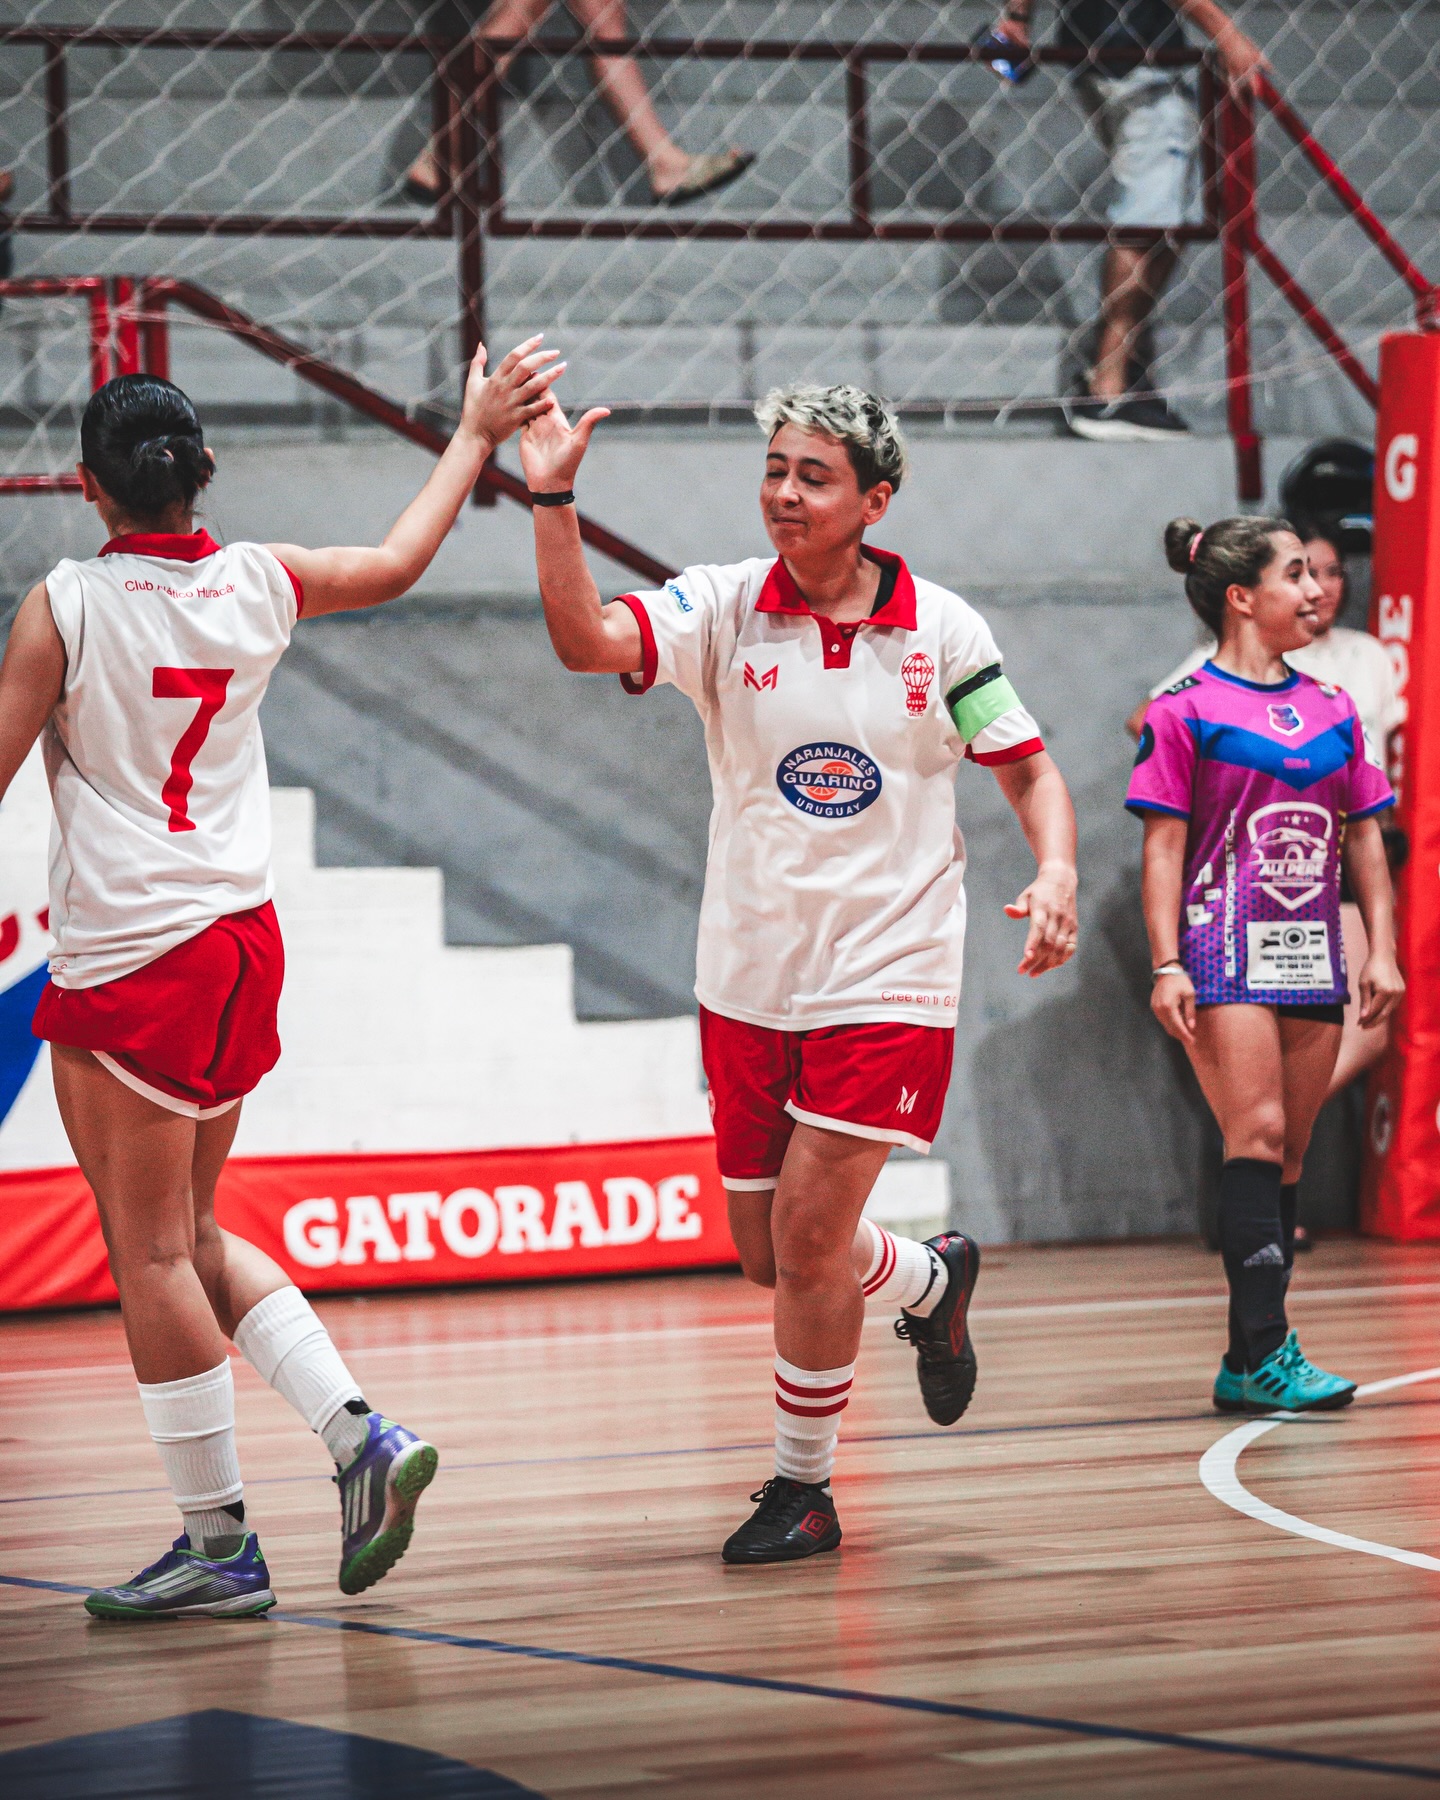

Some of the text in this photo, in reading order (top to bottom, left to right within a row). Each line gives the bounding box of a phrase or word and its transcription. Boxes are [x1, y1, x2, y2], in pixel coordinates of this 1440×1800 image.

[124, 580, 154, 592] Club
[152, 667, 235, 832] 7
[784, 747, 876, 777] NARANJALES
[783, 772, 877, 791] GUARINO
[796, 797, 861, 816] URUGUAY
[881, 991, 912, 1002] Cree
[916, 995, 930, 1005] en
[283, 1175, 701, 1267] GATORADE
